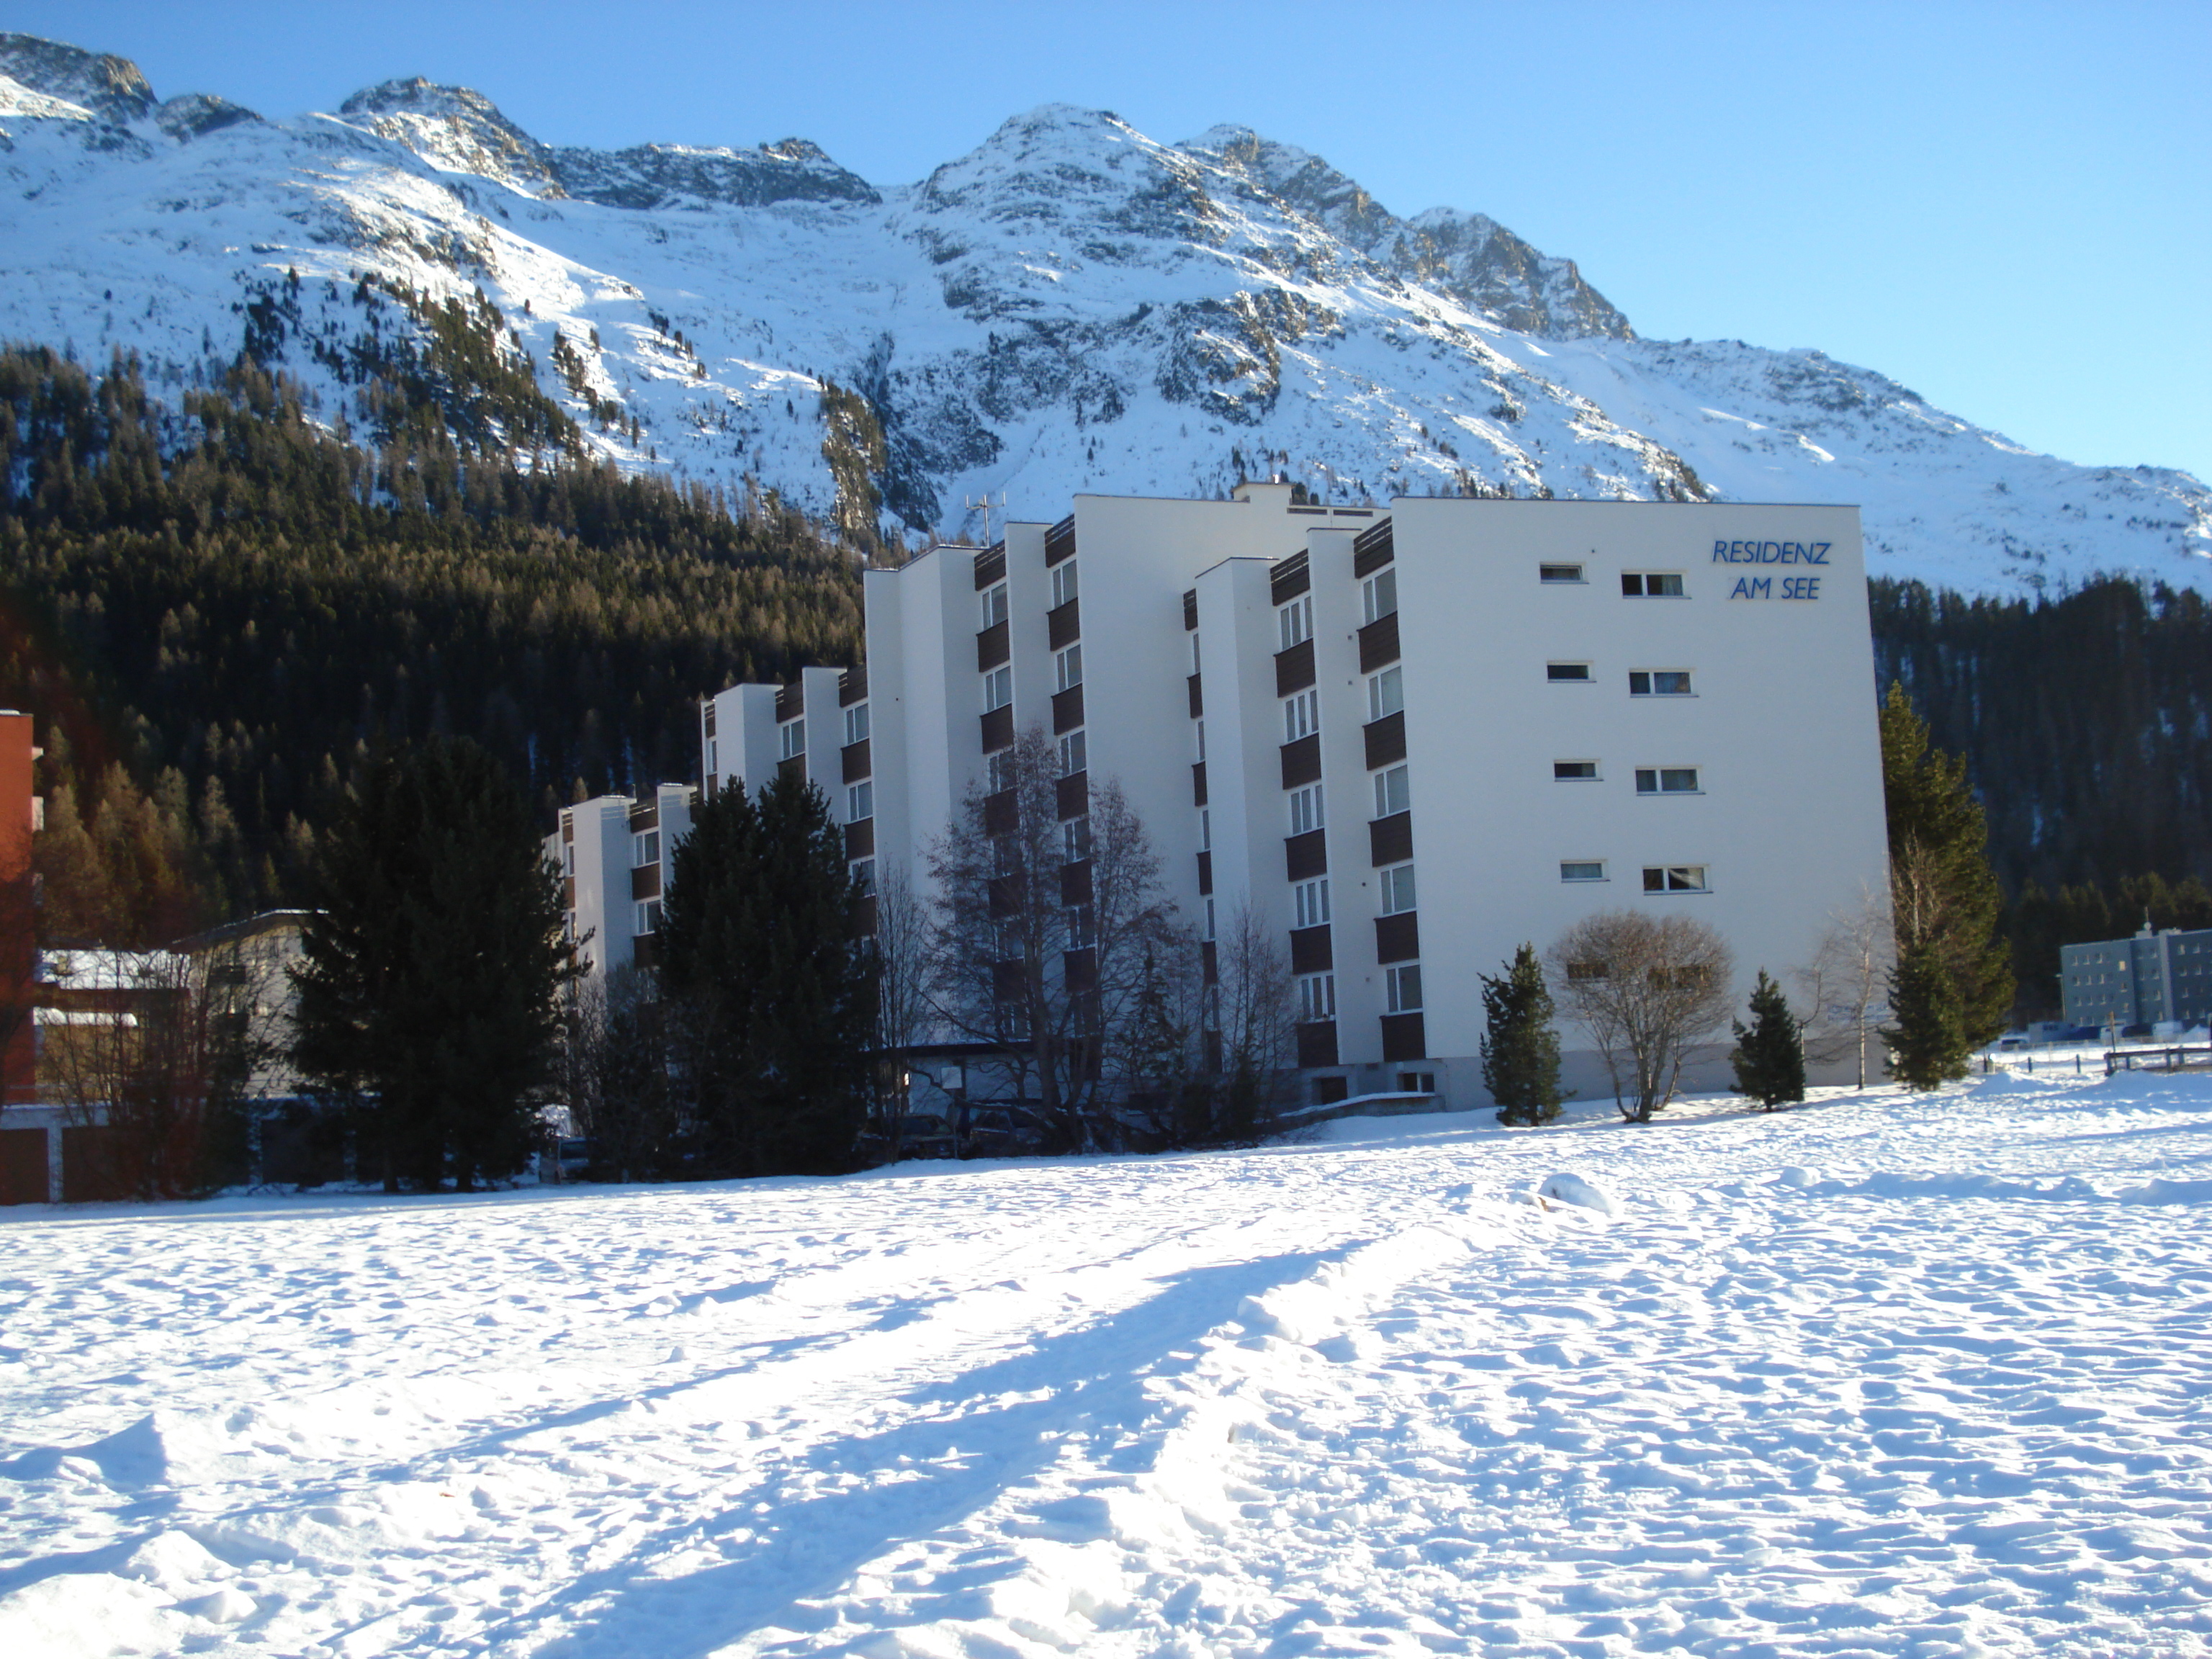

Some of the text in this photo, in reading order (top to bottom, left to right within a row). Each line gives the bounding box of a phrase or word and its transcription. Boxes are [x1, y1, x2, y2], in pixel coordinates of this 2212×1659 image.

[1712, 540, 1832, 565] RESIDENZ
[1730, 577, 1820, 600] AM SEE
